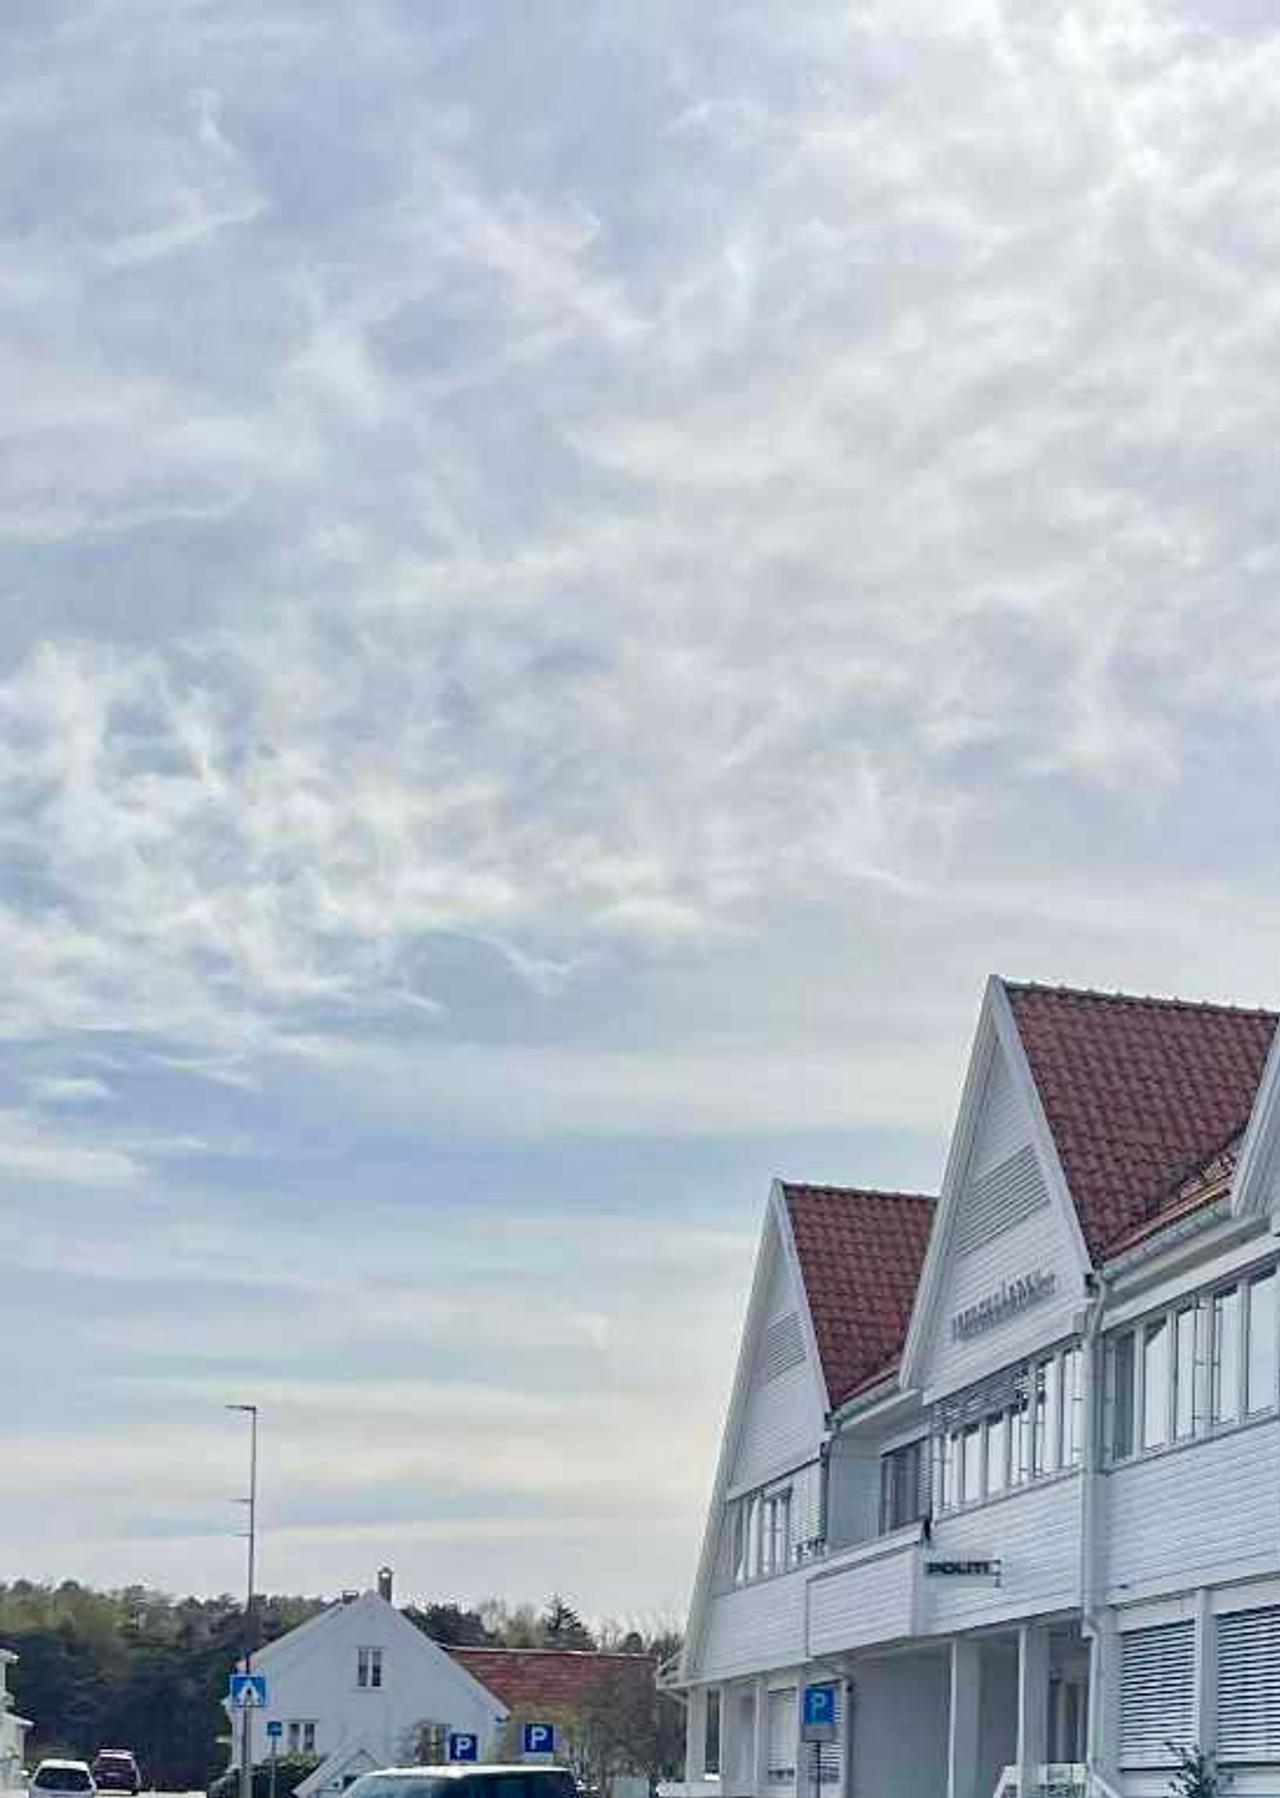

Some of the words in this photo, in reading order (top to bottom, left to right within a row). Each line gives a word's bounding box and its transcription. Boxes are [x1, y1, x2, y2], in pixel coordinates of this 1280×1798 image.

[928, 1561, 990, 1576] POLITI
[811, 1692, 826, 1722] P
[455, 1736, 473, 1758] P
[531, 1726, 548, 1750] P
